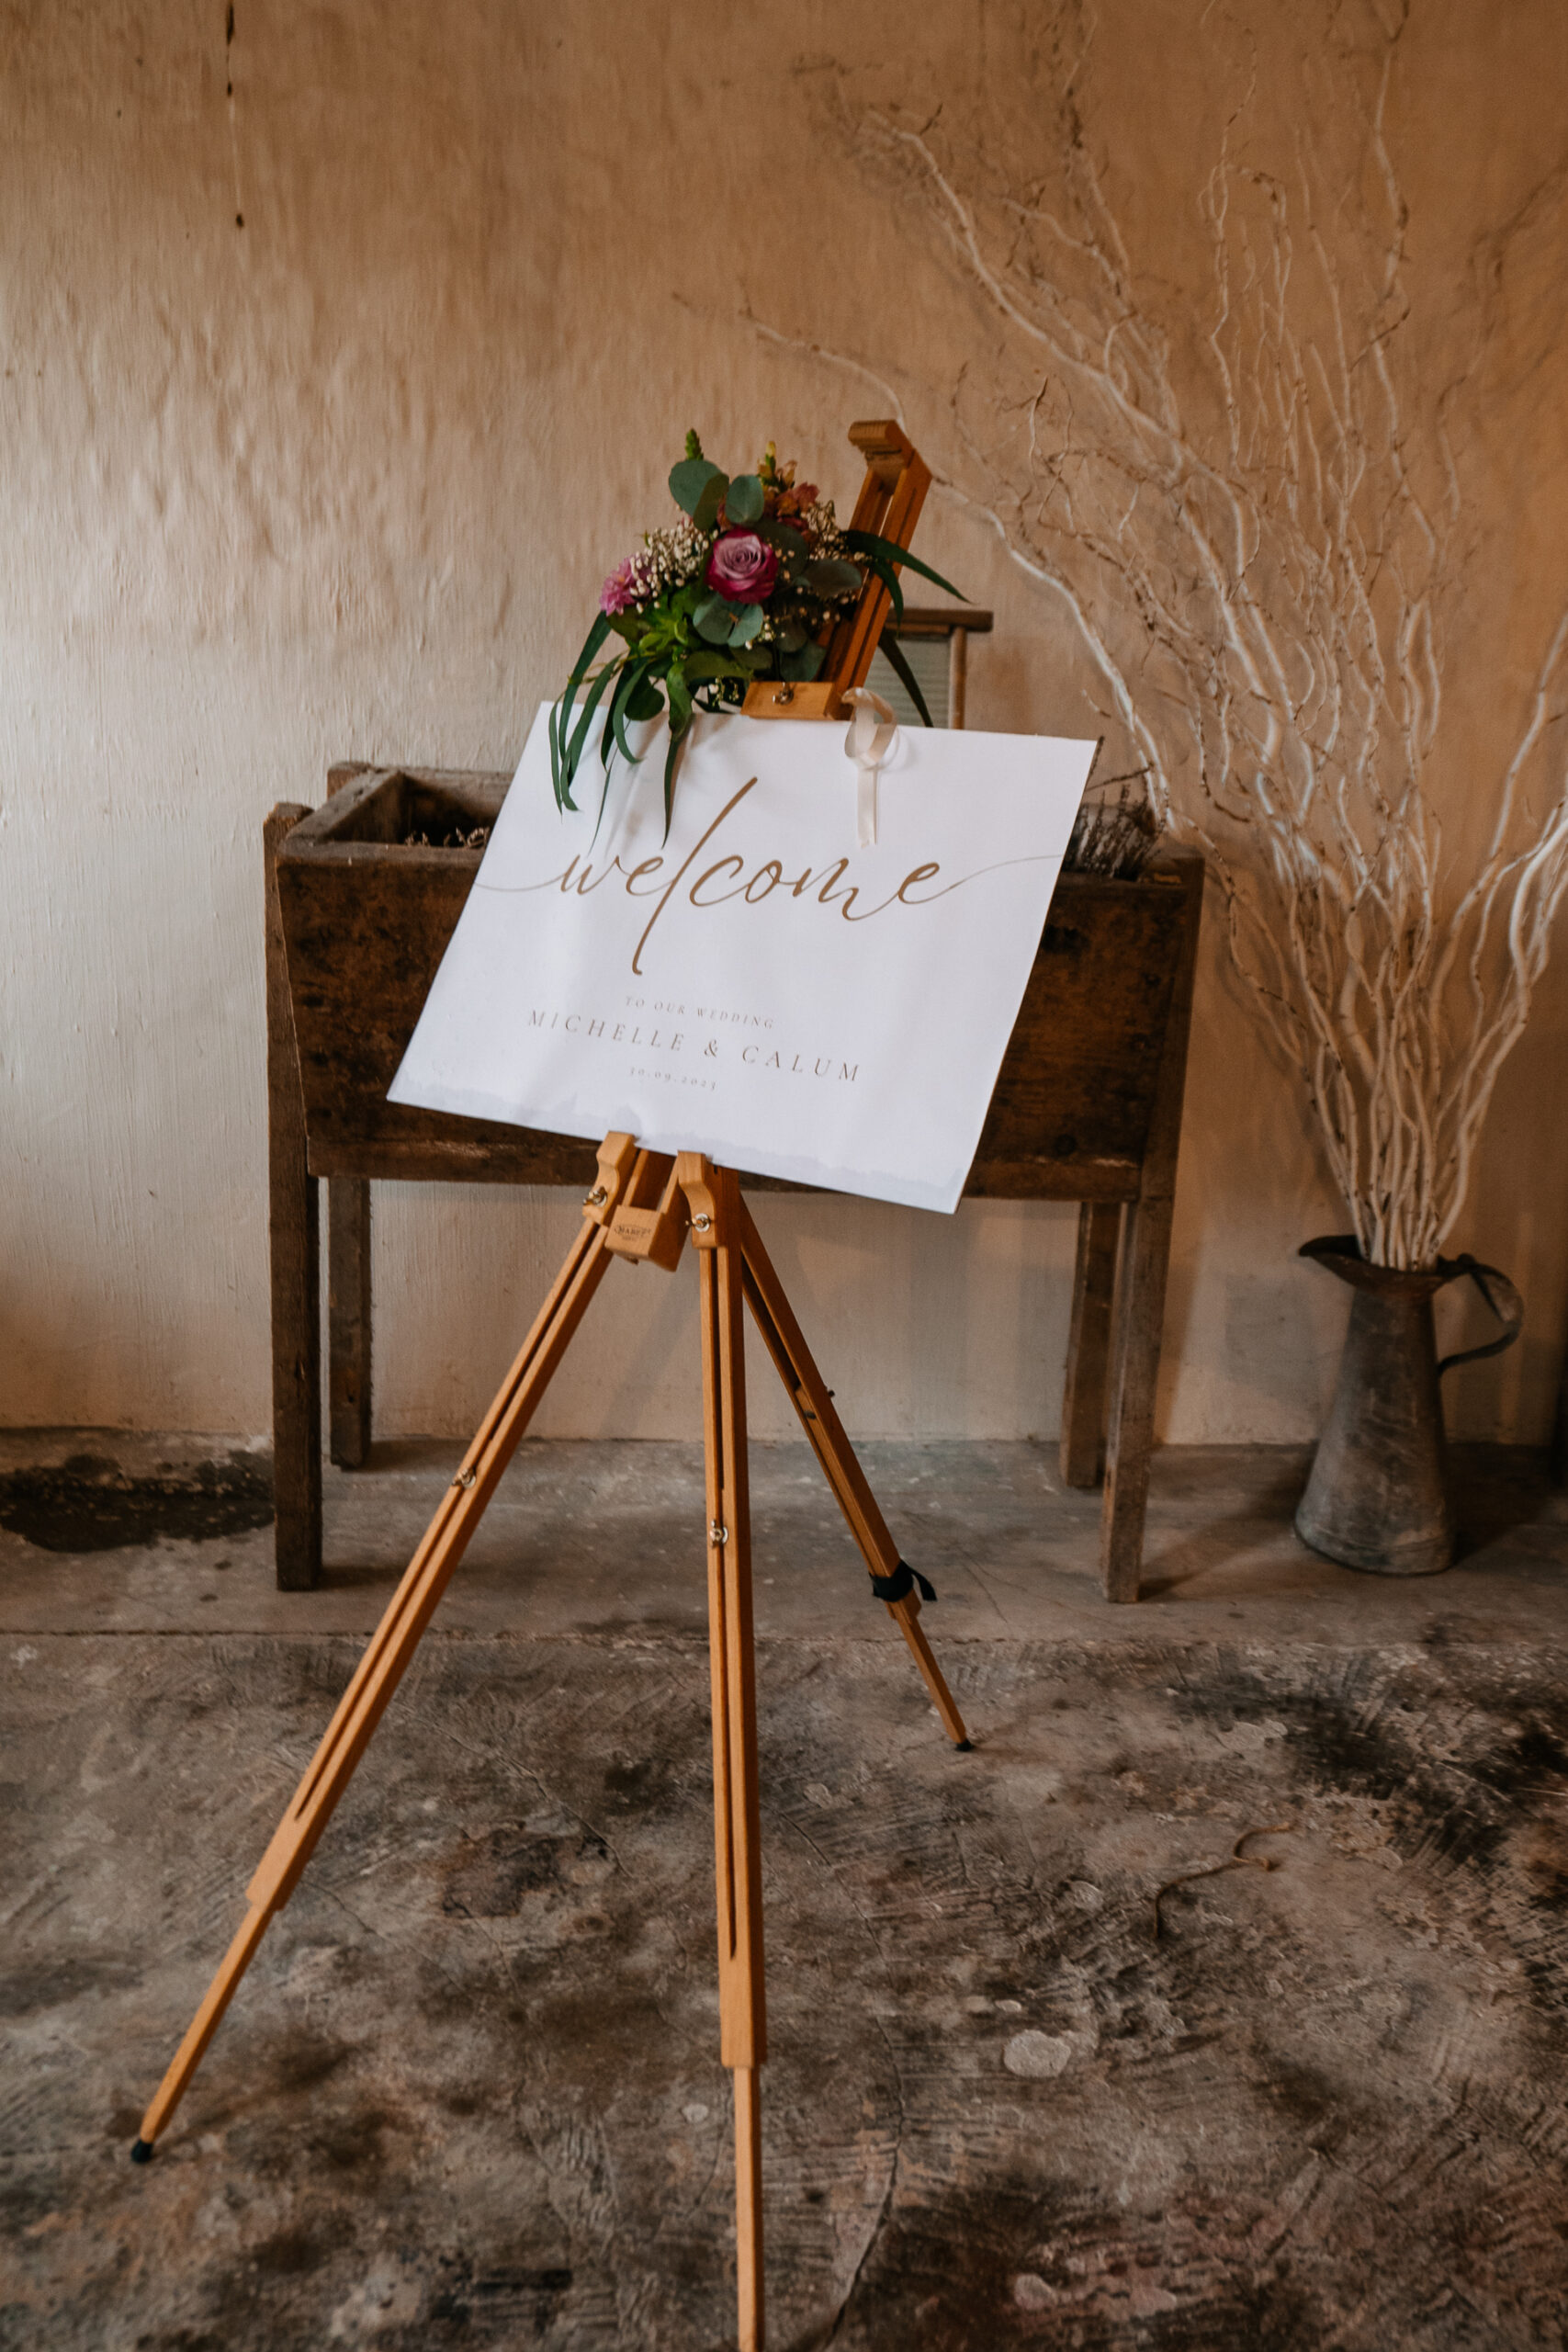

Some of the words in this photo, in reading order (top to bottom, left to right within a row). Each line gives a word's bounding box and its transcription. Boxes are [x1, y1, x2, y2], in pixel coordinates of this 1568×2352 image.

[474, 775, 1063, 975] welcome
[527, 1009, 685, 1052] MICHELLE
[703, 1039, 719, 1058] &
[741, 1045, 860, 1082] CALUM
[625, 995, 646, 1009] TO
[653, 1000, 686, 1015] OUR
[696, 1007, 774, 1030] WEDDING
